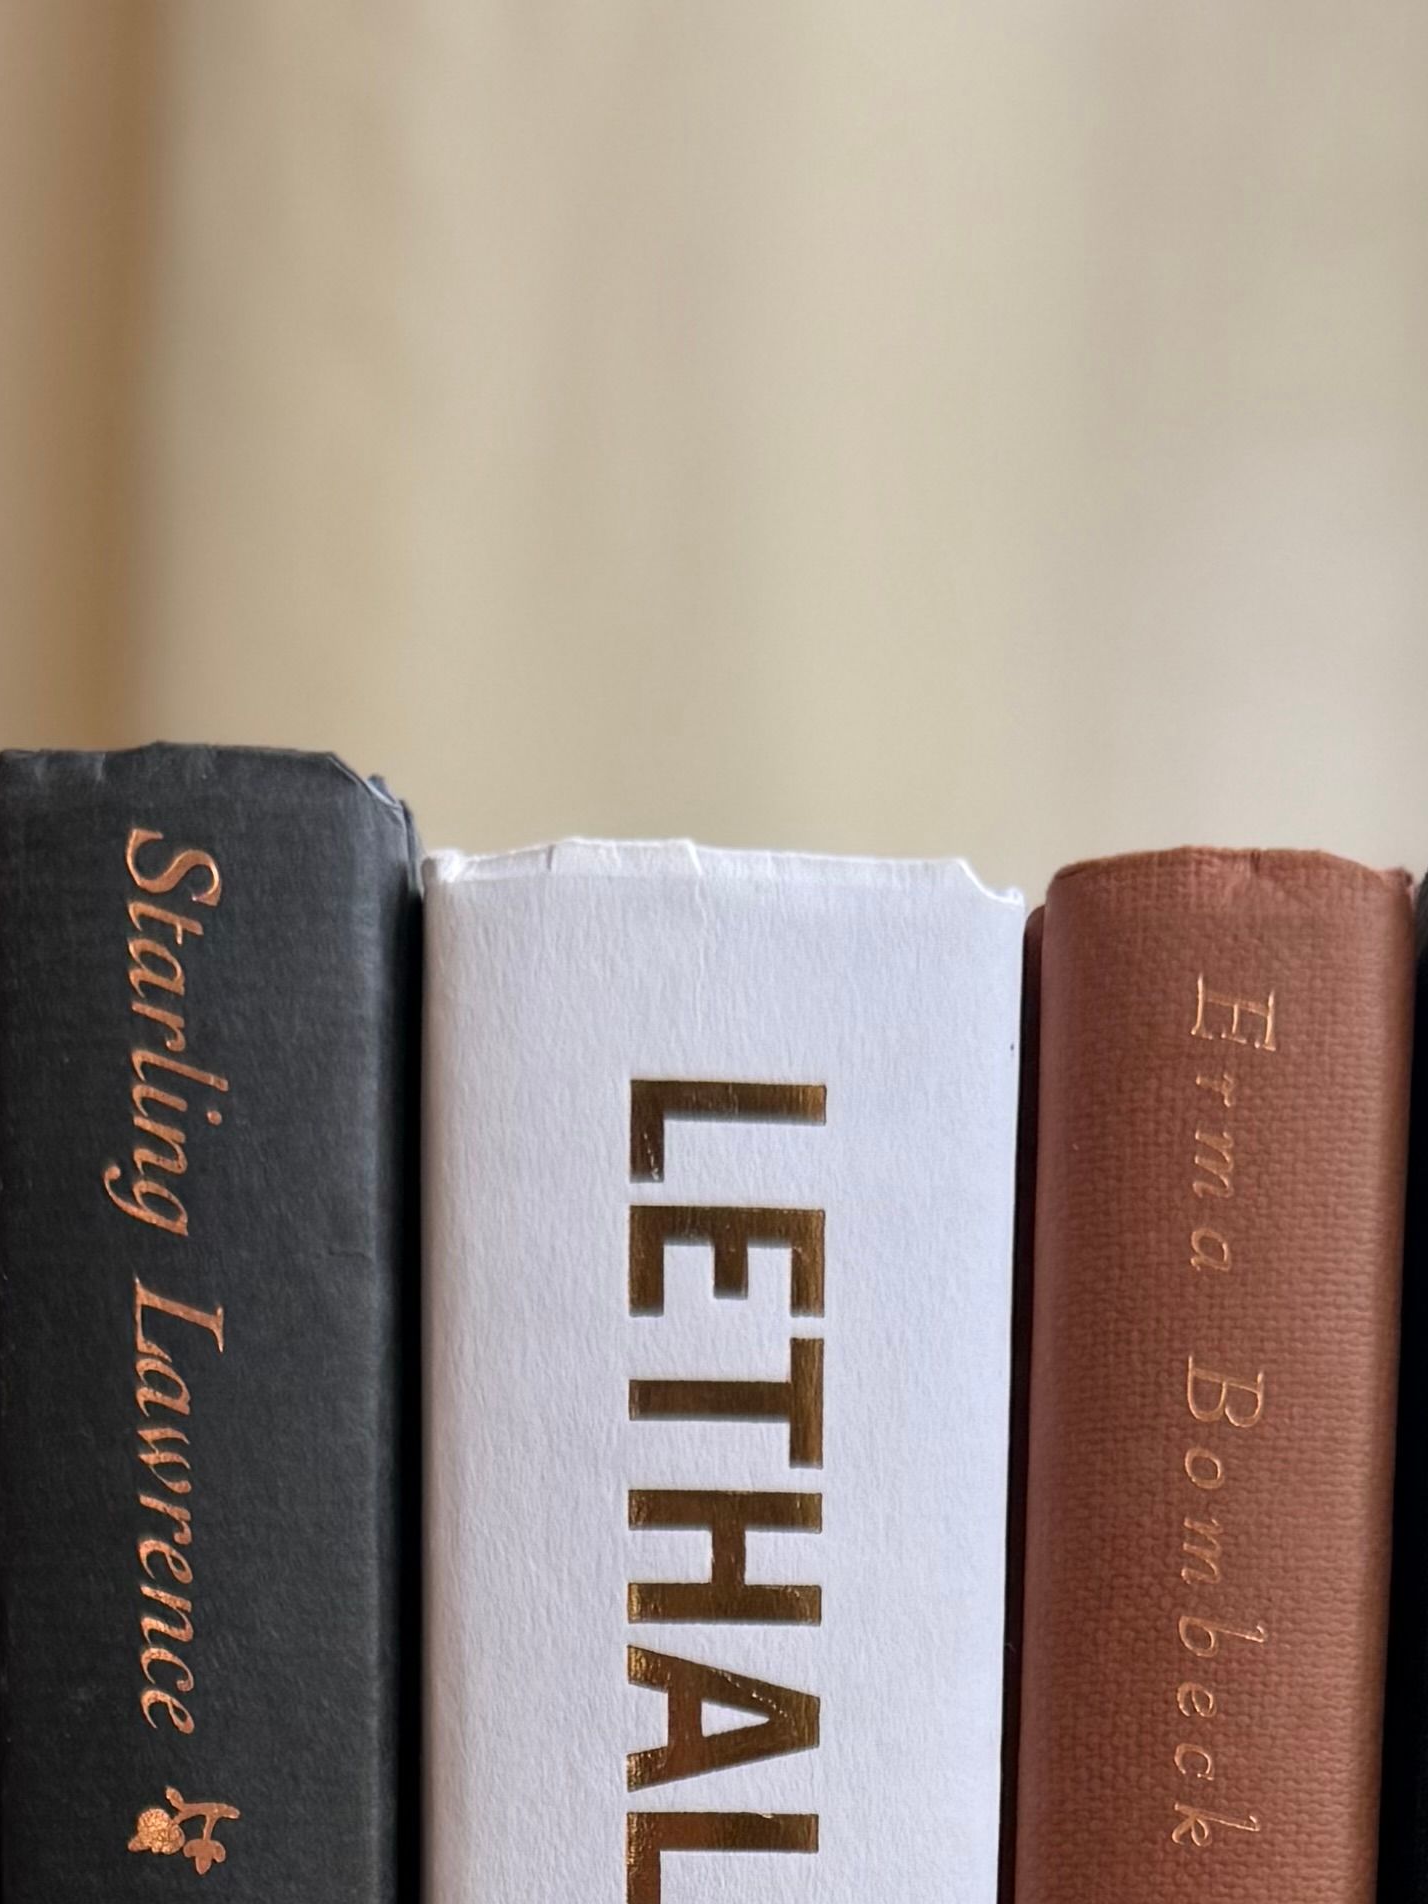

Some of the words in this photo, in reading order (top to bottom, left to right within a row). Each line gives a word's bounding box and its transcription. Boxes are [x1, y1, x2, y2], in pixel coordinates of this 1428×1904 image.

[103, 826, 229, 1235] Starling
[1179, 972, 1278, 1279] Erma
[135, 1278, 224, 1734] Lawrence
[1166, 1355, 1267, 1854] Bombeck
